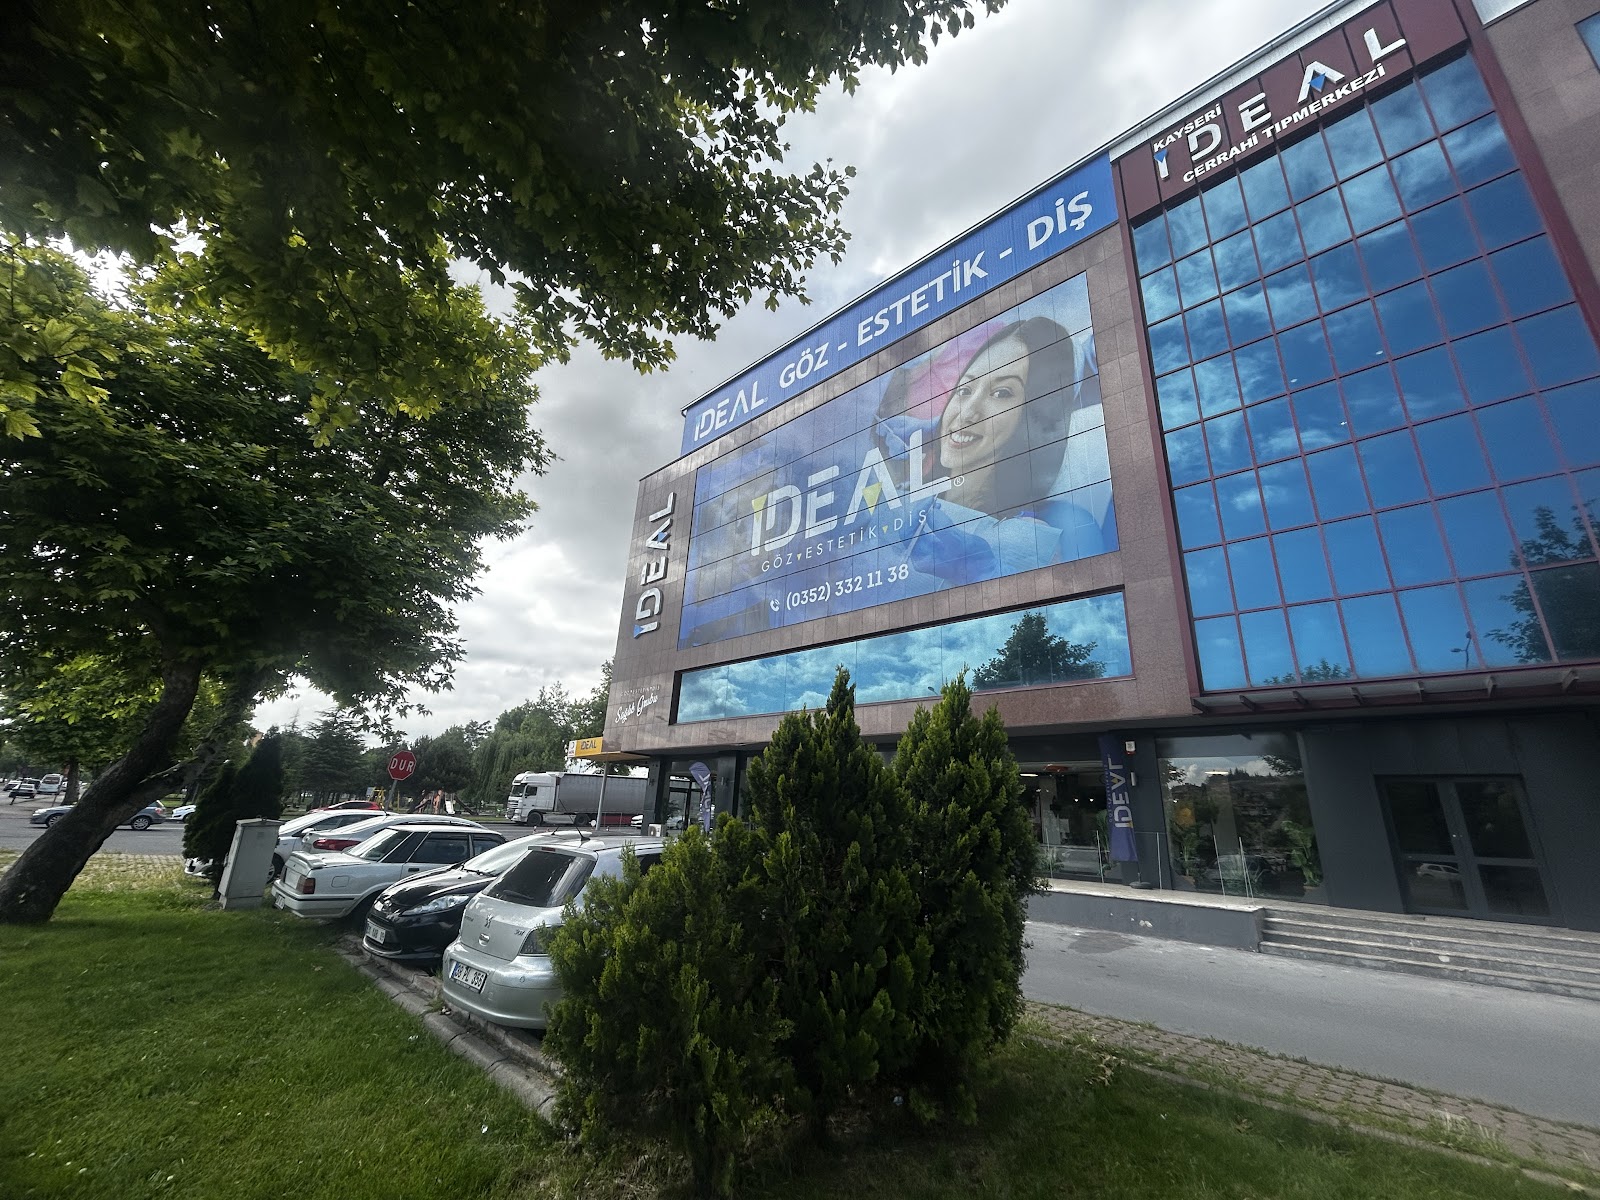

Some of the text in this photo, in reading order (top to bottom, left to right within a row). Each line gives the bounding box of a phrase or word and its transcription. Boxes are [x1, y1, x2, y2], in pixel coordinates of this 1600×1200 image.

[1153, 103, 1221, 152] KAYSERİ
[1182, 133, 1258, 183] CERRAHİ
[779, 342, 828, 389] GÖZ
[857, 250, 989, 347] ESTETİK
[1027, 190, 1093, 251] DİŞ
[761, 553, 793, 572] GÖZ
[805, 525, 877, 559] ESTETİK
[786, 563, 909, 611] (0352) 332 11 38
[390, 758, 414, 772] DUR
